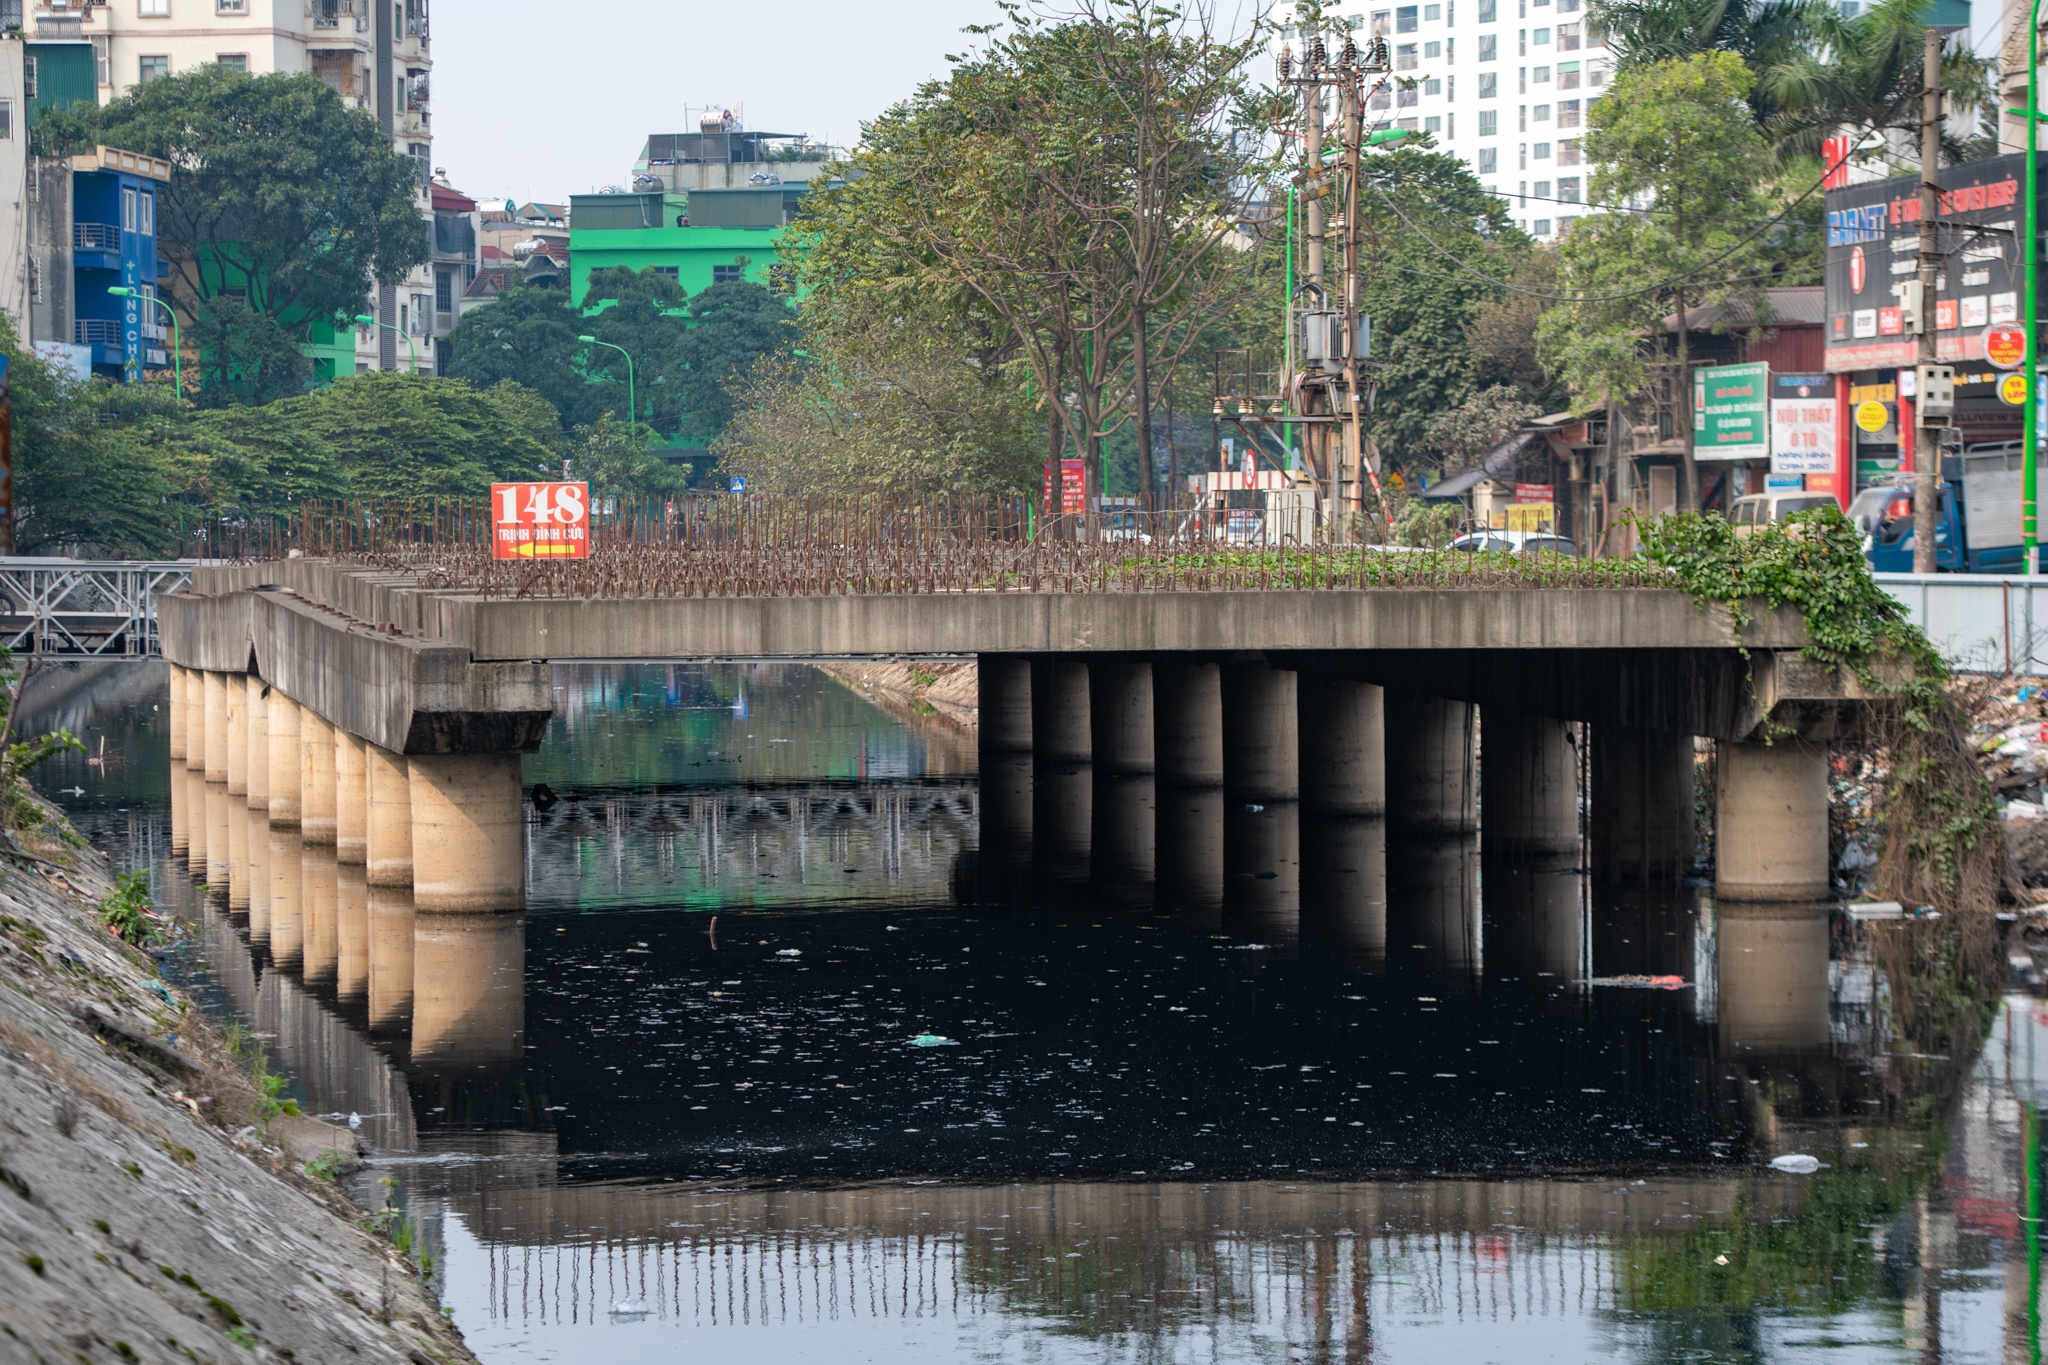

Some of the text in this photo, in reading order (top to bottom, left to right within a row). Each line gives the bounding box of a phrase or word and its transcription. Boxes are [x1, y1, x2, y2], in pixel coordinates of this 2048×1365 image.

[1828, 203, 1888, 247] CARNET
[1778, 376, 1828, 387] CARNET
[1777, 405, 1798, 426] NỘI
[1802, 402, 1832, 424] THẤT
[1791, 429, 1817, 447] Ô TÔ
[496, 485, 584, 523] 148
[498, 523, 585, 543] TRỊNH ĐÌNH CỬU
